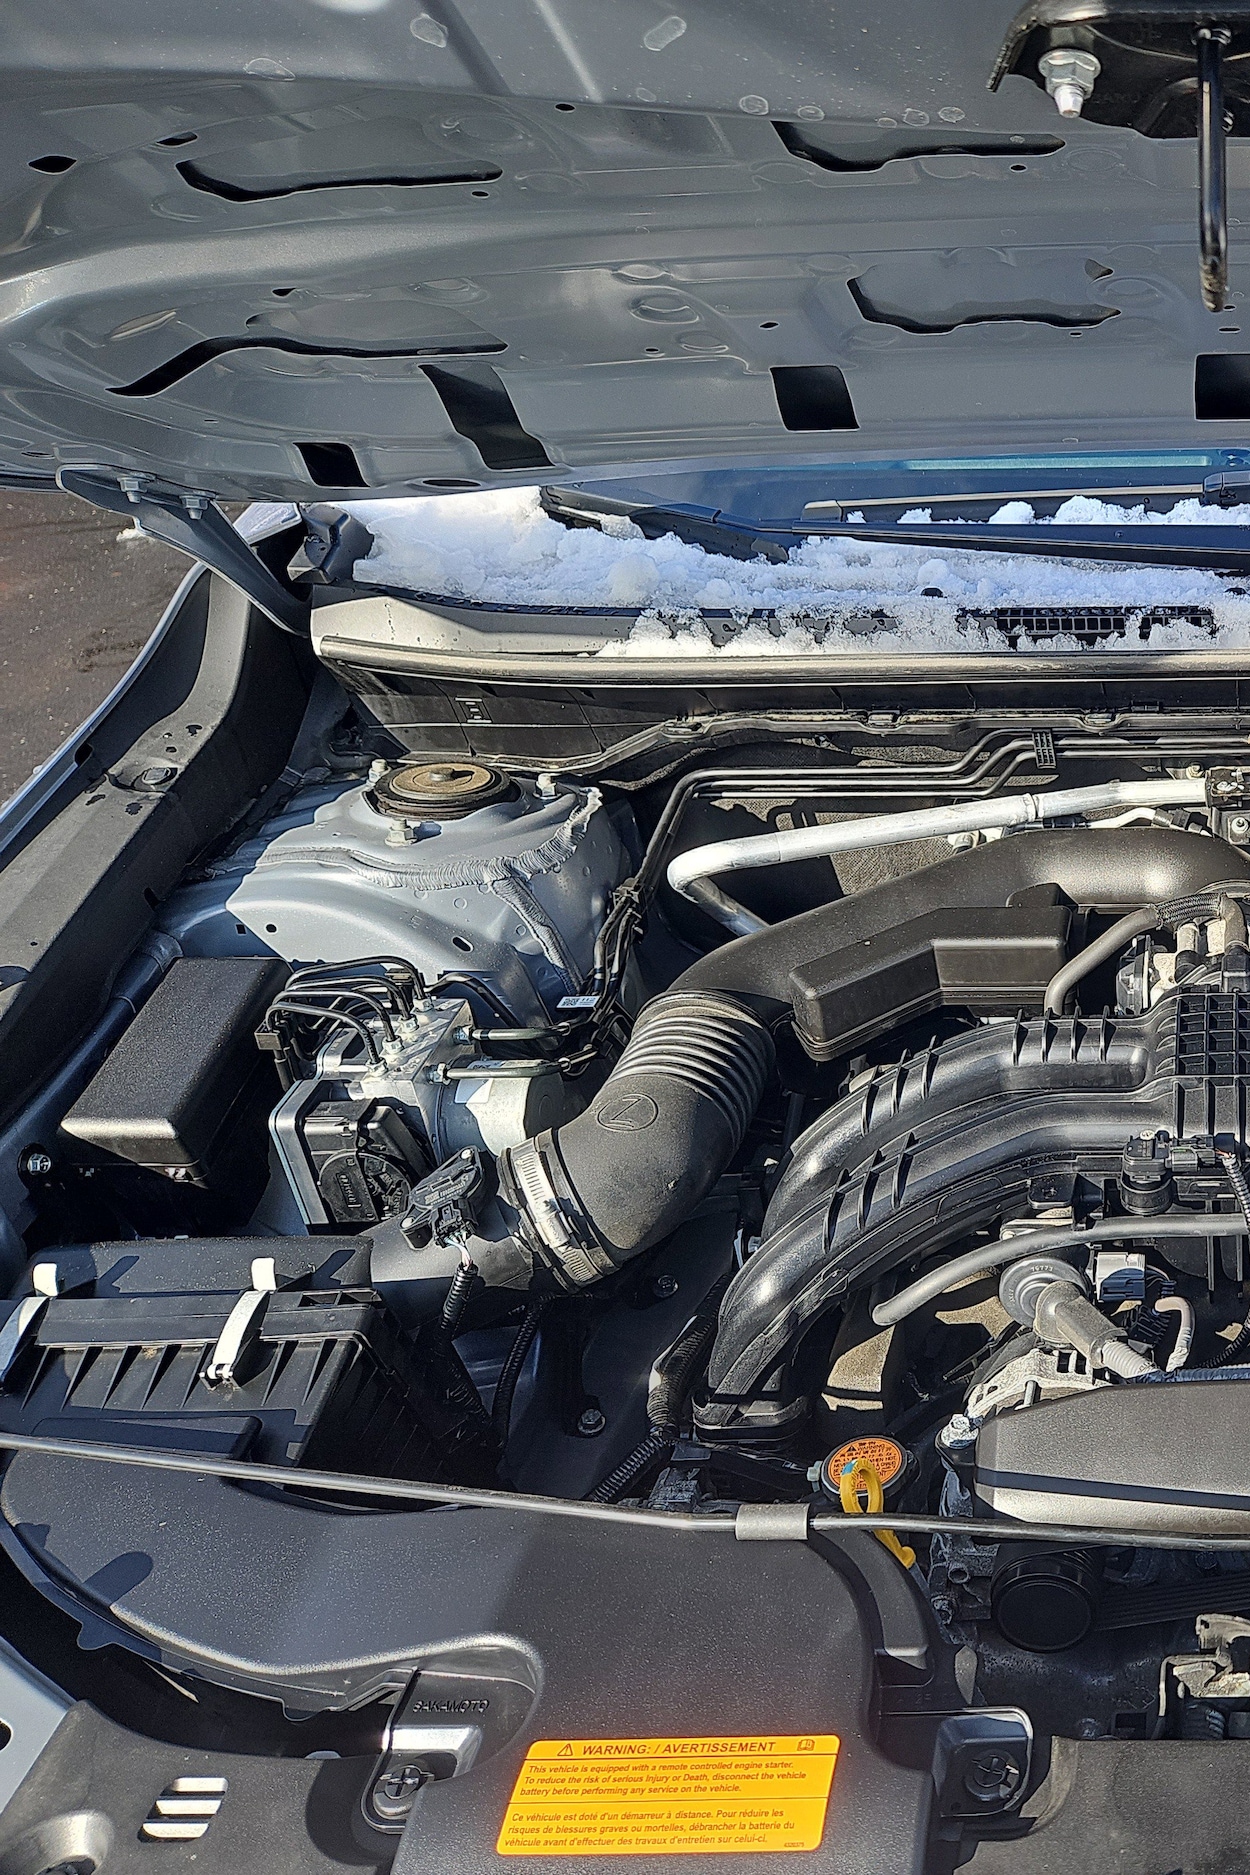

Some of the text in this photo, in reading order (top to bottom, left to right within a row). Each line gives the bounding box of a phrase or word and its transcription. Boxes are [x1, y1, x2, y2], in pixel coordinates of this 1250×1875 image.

[413, 1699, 490, 1714] SAKAMOTO
[581, 1743, 652, 1755] WARNING:
[661, 1741, 776, 1753] AVERTISSEMENT
[527, 1764, 547, 1773] This
[548, 1764, 580, 1773] vehicle
[589, 1763, 630, 1772] equipped
[631, 1762, 650, 1772] with
[650, 1762, 657, 1771] a
[657, 1762, 688, 1771] remote
[689, 1761, 733, 1771] controlled
[733, 1761, 763, 1770] engine
[523, 1775, 535, 1784] To
[535, 1775, 567, 1784] reduce
[567, 1775, 582, 1783] the
[582, 1774, 600, 1783] risk
[600, 1774, 612, 1783] of
[611, 1773, 644, 1783] serious
[670, 1773, 681, 1781] or
[711, 1771, 759, 1781] disconnect
[760, 1771, 775, 1780] the
[775, 1770, 807, 1779] vehicle
[518, 1787, 551, 1796] battery
[550, 1786, 580, 1796] before
[580, 1785, 629, 1795] performing
[629, 1785, 645, 1794] any
[647, 1784, 679, 1794] service
[679, 1784, 692, 1793] on
[692, 1784, 708, 1793] the
[510, 1813, 525, 1821] Ce
[525, 1812, 562, 1821] véhicule
[562, 1812, 577, 1820] est
[577, 1811, 598, 1820] doté
[619, 1810, 664, 1819] démarreur
[715, 1809, 737, 1817] Pour
[738, 1808, 770, 1817] réduire
[771, 1808, 785, 1816] les
[507, 1825, 541, 1834] risques
[541, 1825, 554, 1834] de
[554, 1824, 598, 1834] blessures
[599, 1823, 629, 1833] graves
[630, 1823, 643, 1832] ou
[688, 1821, 737, 1831] débrancher
[738, 1821, 747, 1830] la
[747, 1820, 781, 1830] batterie
[782, 1820, 795, 1829] du
[503, 1837, 542, 1846] véhicule
[542, 1836, 568, 1846] avant
[616, 1835, 634, 1844] des
[634, 1835, 668, 1844] travaux
[716, 1833, 732, 1842] sur
